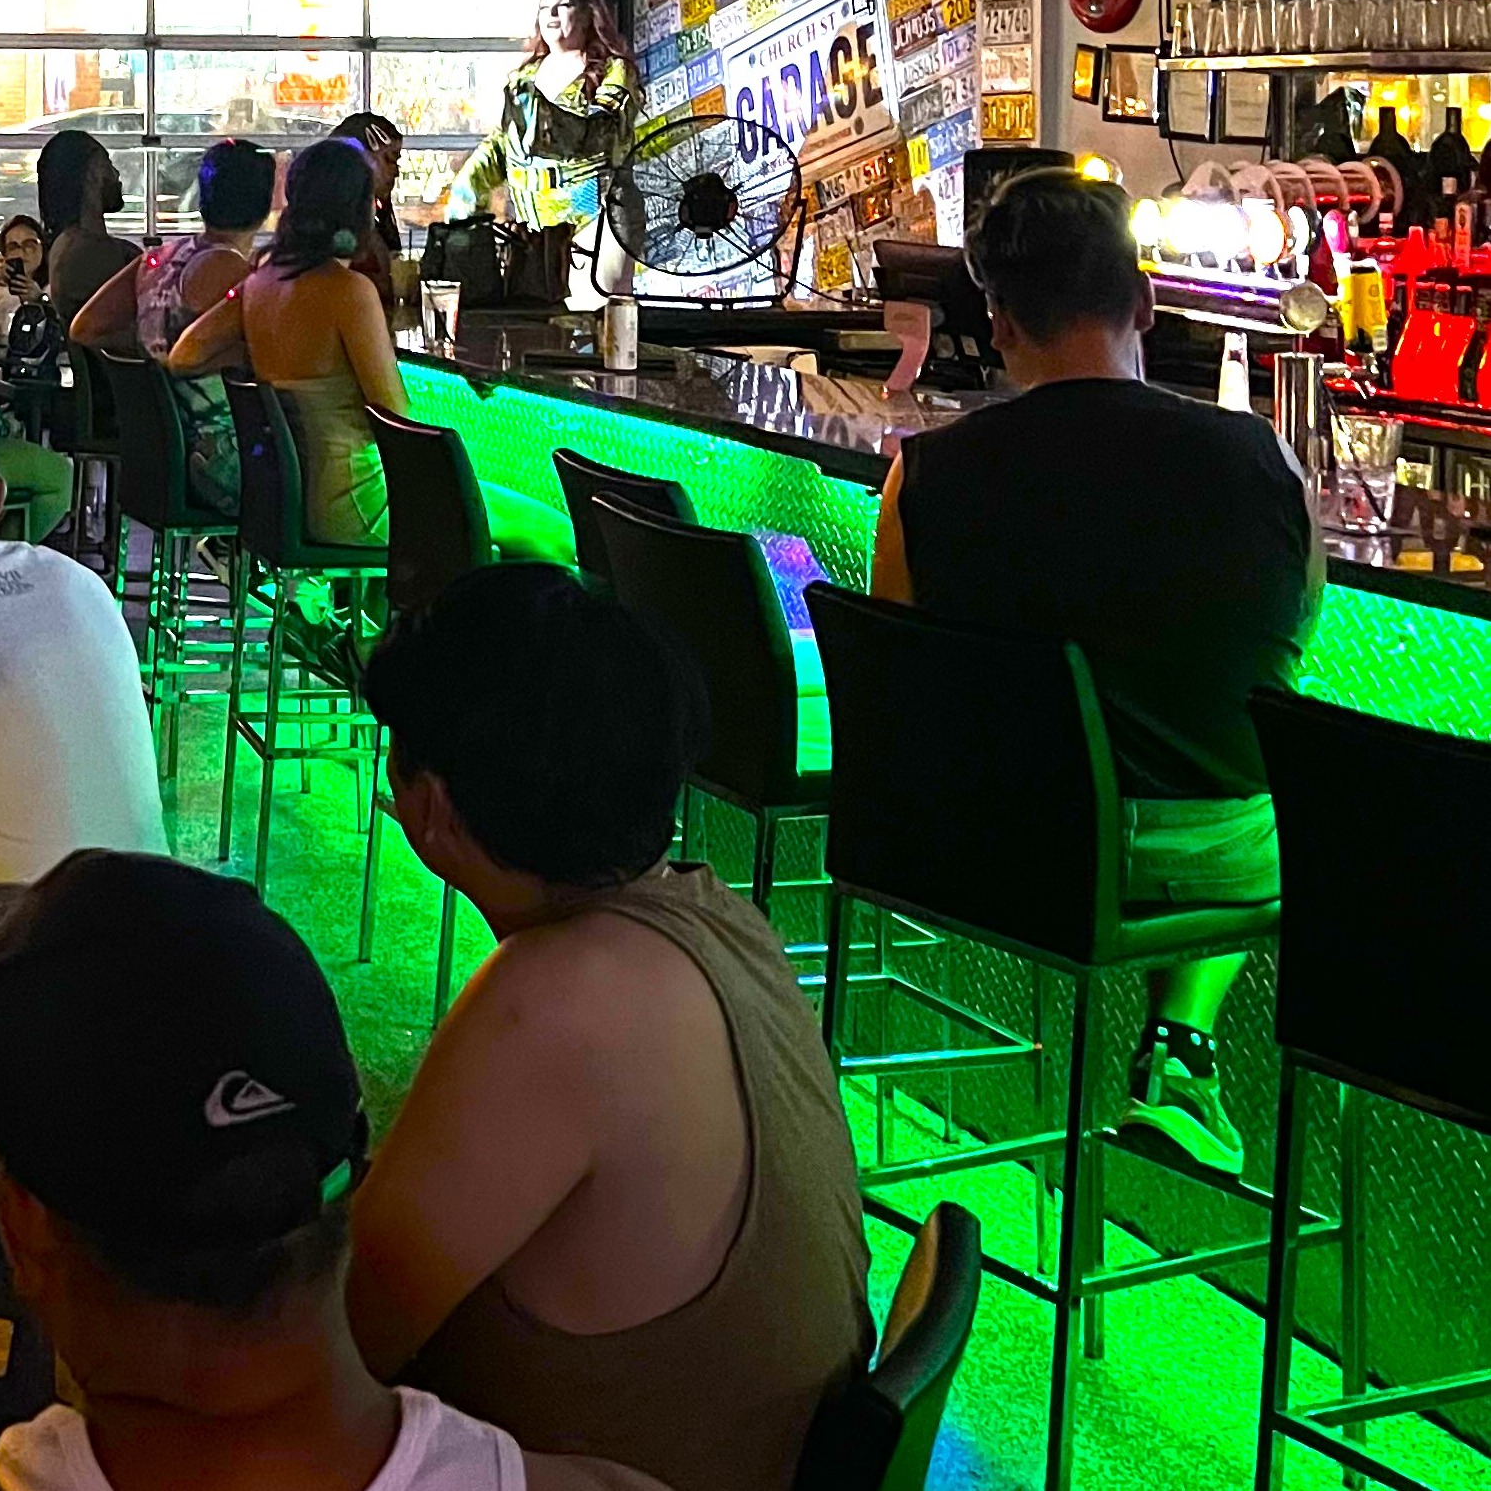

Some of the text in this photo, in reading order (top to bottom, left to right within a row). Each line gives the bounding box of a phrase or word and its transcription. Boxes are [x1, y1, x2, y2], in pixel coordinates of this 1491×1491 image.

[759, 11, 836, 67] CHURCH ST
[736, 21, 884, 164] GARAGE
